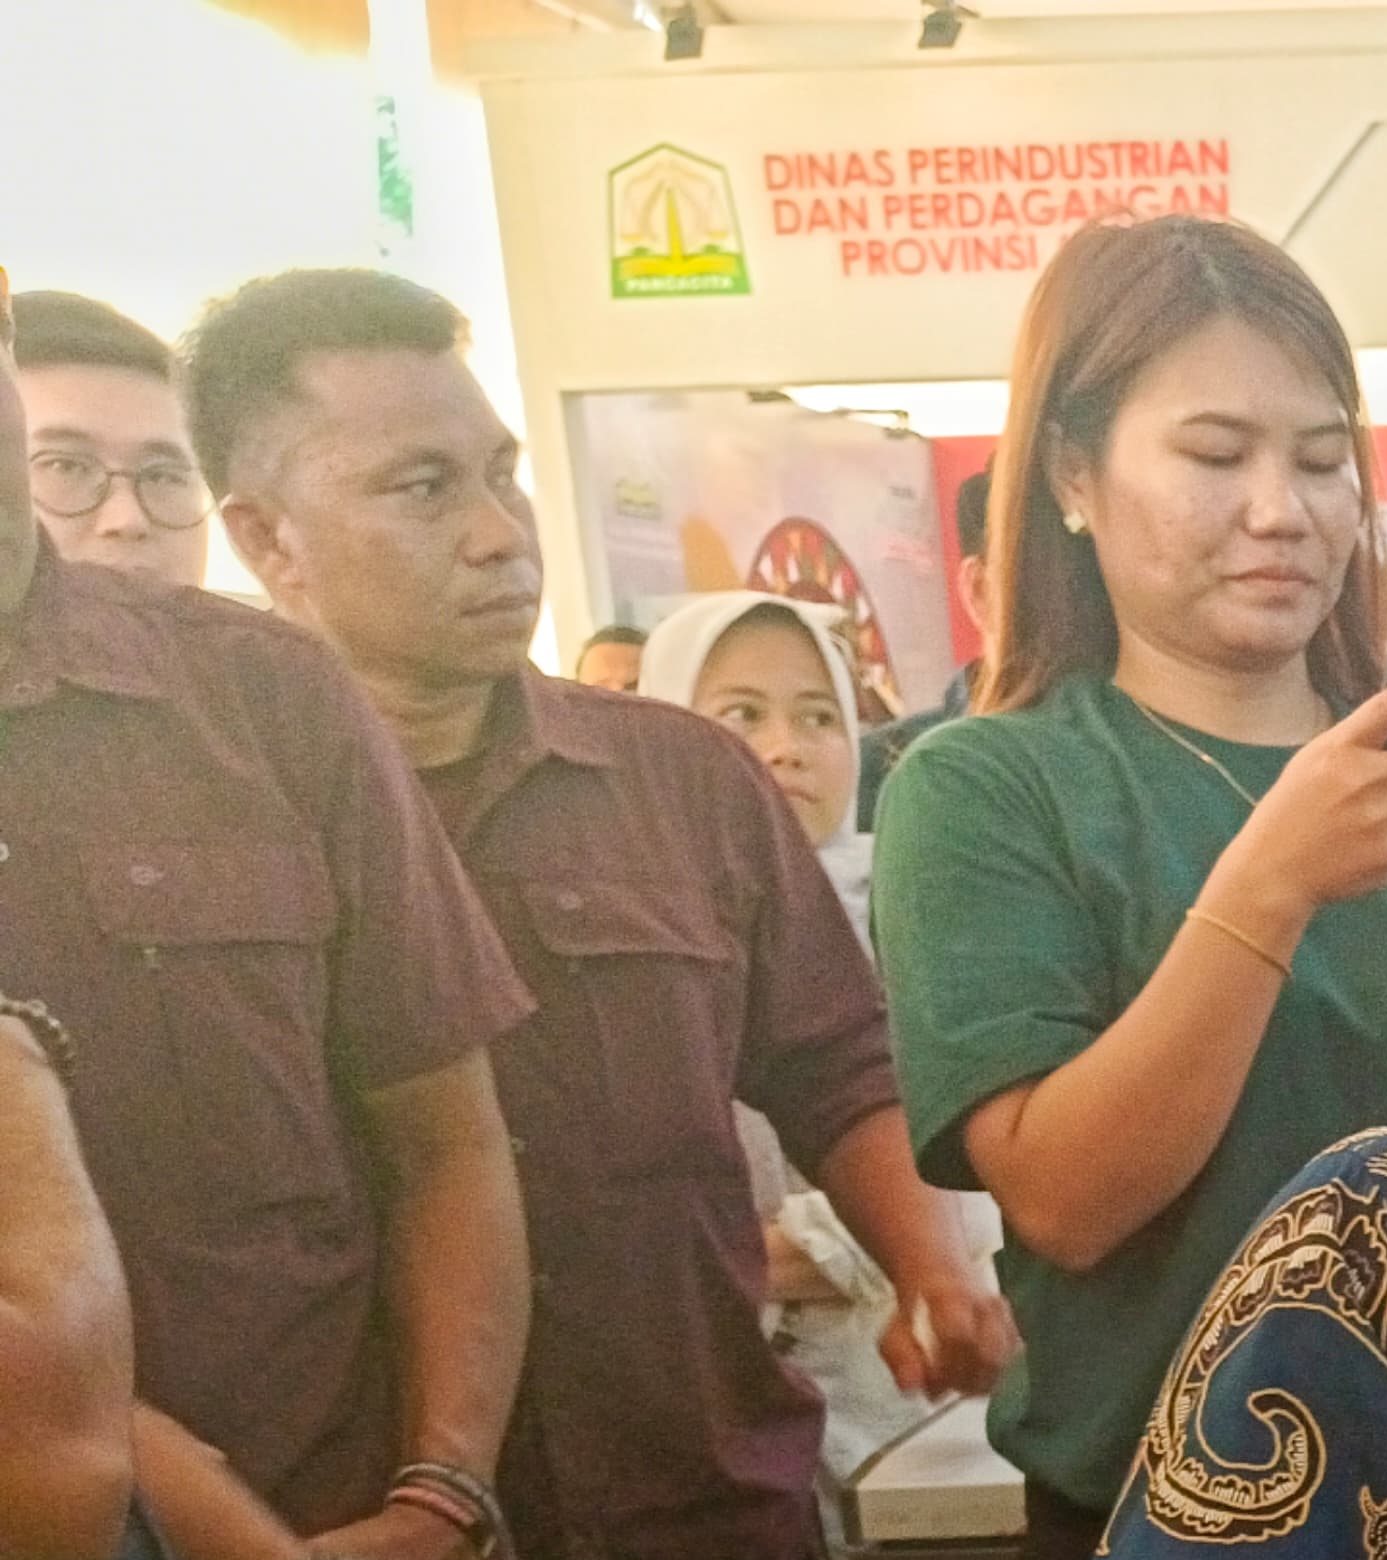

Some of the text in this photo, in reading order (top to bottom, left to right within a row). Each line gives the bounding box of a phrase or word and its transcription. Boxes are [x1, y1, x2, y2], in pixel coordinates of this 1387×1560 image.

[764, 139, 1230, 192] DINAS PERINDUSTRIAN
[774, 184, 1230, 236] DAN PERDAGANGAN
[841, 235, 1038, 278] PROVINSI
